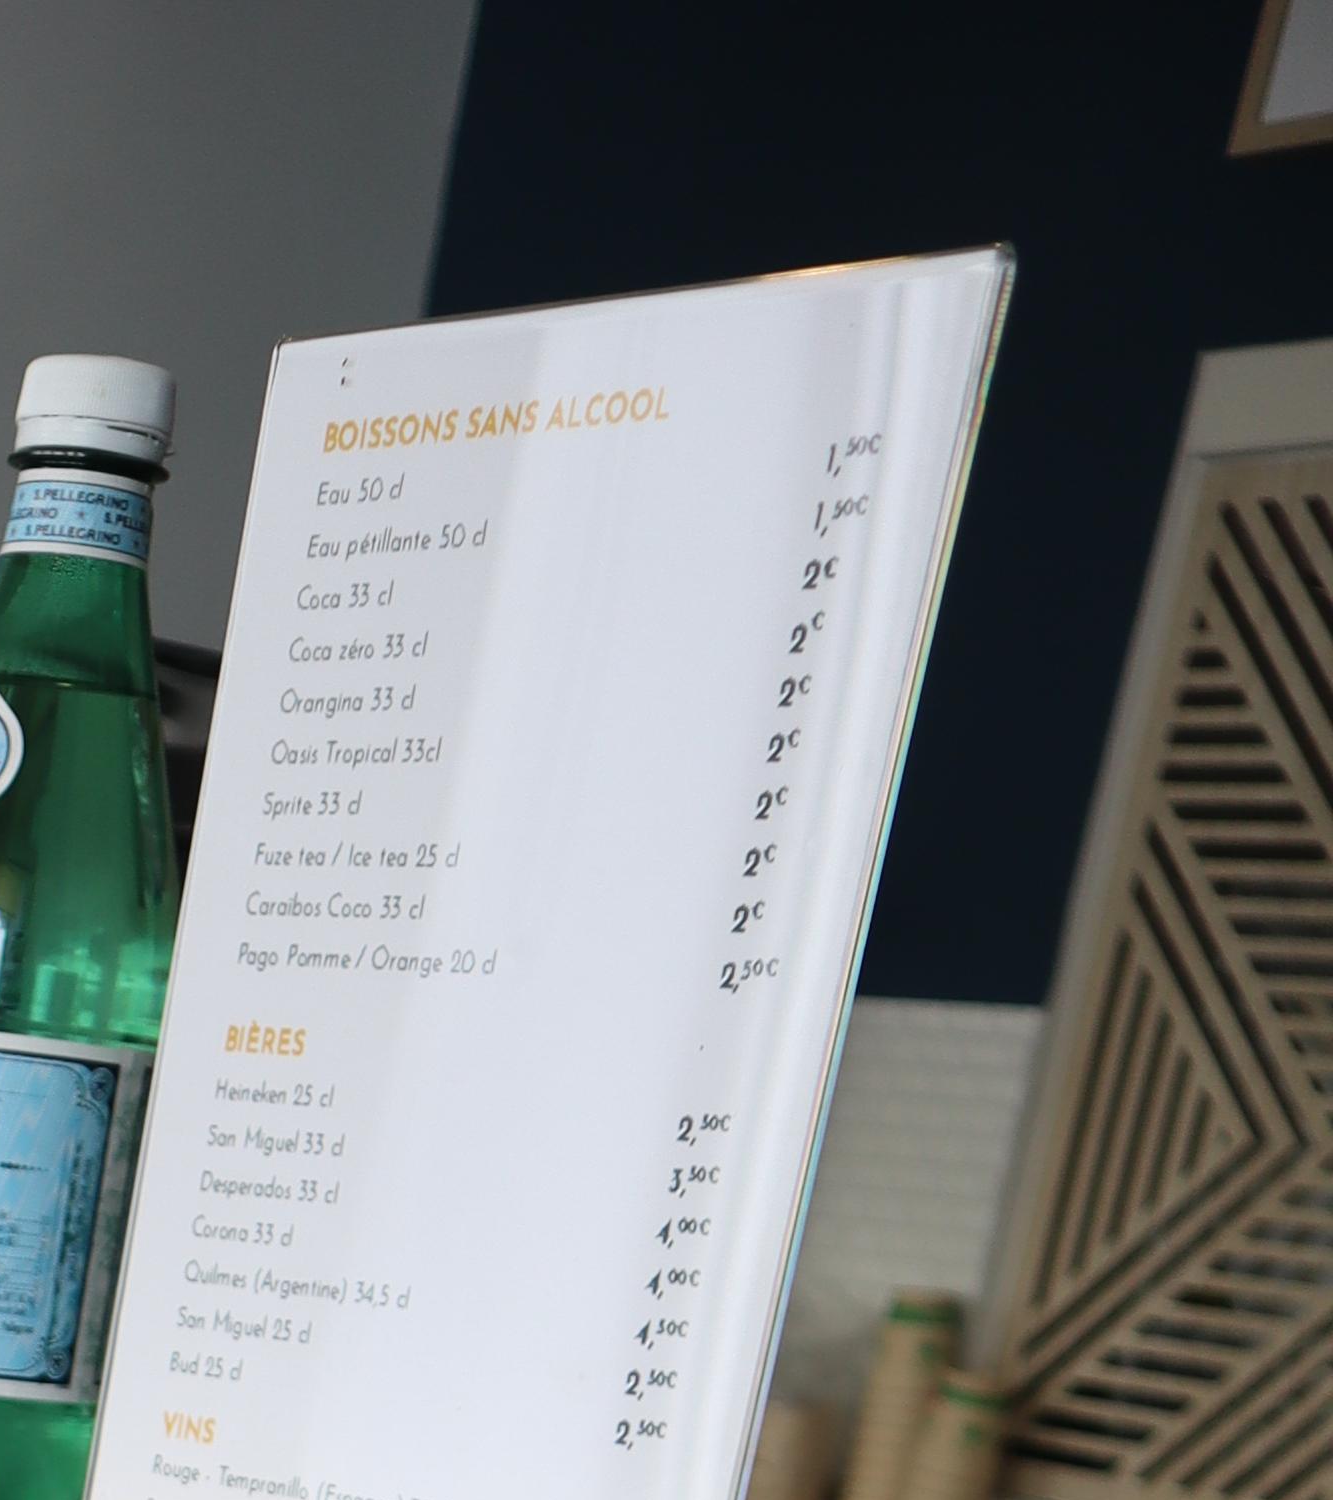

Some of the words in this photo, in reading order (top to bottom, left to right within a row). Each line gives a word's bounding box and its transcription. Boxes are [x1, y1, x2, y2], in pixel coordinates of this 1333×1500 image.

[322, 410, 458, 454] BOISSONS
[465, 401, 538, 440] SANS
[545, 387, 669, 432] ALCOOL
[317, 482, 350, 506] Eau
[358, 477, 384, 502] 50
[308, 535, 340, 558] Eau
[345, 528, 431, 561] pétillante
[438, 523, 466, 549] 50
[297, 585, 341, 610] Coca
[348, 583, 369, 608] 33
[377, 581, 394, 606] cl
[289, 637, 331, 662] Coca
[339, 633, 374, 661] zéro
[383, 634, 404, 658] 33
[412, 631, 429, 658] cl
[280, 688, 362, 718] Orangina
[371, 688, 393, 711] 33
[271, 739, 318, 764] Oasis
[326, 738, 398, 769] Tropical
[262, 792, 312, 820] Sprite
[318, 792, 340, 816] 33
[254, 842, 292, 867] Fuze
[299, 847, 325, 867] tea
[348, 844, 372, 867] Ice
[380, 847, 407, 867] tea
[415, 844, 437, 868] 25
[327, 893, 372, 918] Coco
[380, 896, 402, 919] 33
[237, 942, 278, 972] Pago
[287, 944, 351, 969] Pomme
[371, 945, 442, 978] Orange
[451, 950, 476, 974] 20
[224, 1020, 306, 1057] BIÈRES
[215, 1078, 286, 1105] Heineken
[293, 1084, 313, 1106] 25
[207, 1124, 235, 1147] San
[244, 1125, 299, 1156] Miguel
[303, 1132, 324, 1155] 33
[200, 1170, 292, 1200] Desperados
[298, 1179, 318, 1202] 33
[192, 1214, 249, 1243] Corona
[253, 1222, 274, 1245] 33
[184, 1259, 246, 1289] Quilmes
[254, 1267, 348, 1304] (Argentine)
[177, 1306, 205, 1330] San
[213, 1310, 266, 1341] Miguel
[272, 1318, 292, 1342] 25
[169, 1351, 198, 1375] Bud
[204, 1356, 223, 1379] 25
[163, 1410, 216, 1444] VINS
[153, 1454, 200, 1485] Rouge
[219, 1465, 309, 1500] Tempranillo
